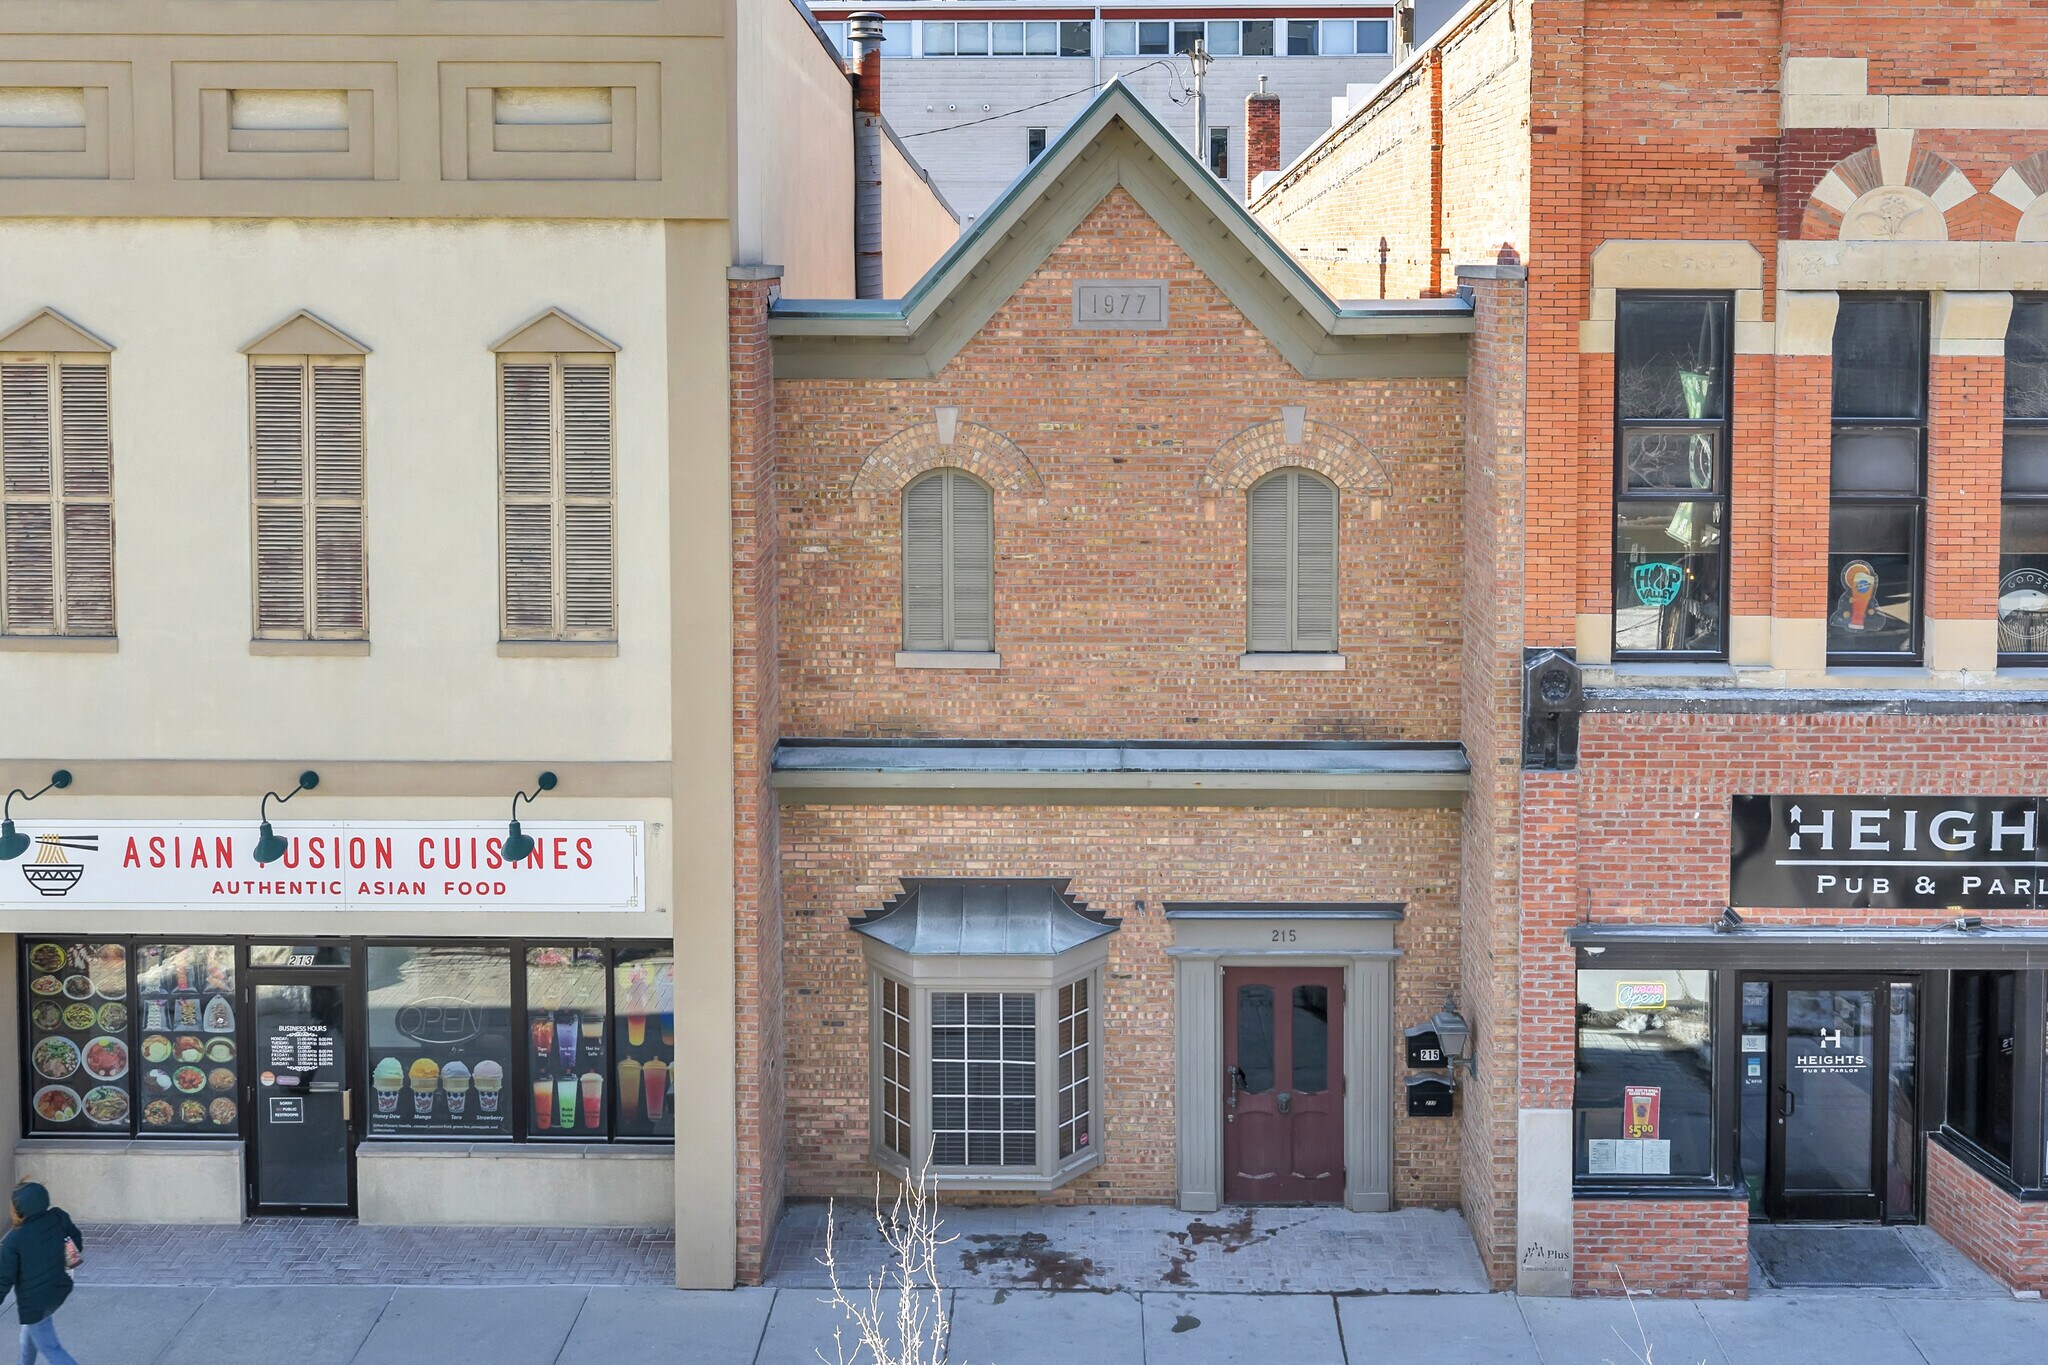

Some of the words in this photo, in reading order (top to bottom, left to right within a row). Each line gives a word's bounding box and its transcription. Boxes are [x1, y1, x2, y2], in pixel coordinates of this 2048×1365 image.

[1093, 294, 1147, 314] 1977
[2008, 574, 2048, 590] GOOSE
[1640, 589, 1674, 600] VALLEY
[1788, 804, 2037, 852] HEIGH
[122, 836, 233, 869] ASIAN
[259, 836, 392, 869] USION
[418, 836, 593, 870] CUISNES
[212, 881, 343, 895] AUTHENTIC
[358, 881, 426, 896] ASIAN
[444, 881, 507, 896] FOOD
[1816, 874, 1890, 894] PUB
[1914, 875, 1936, 895] &
[1271, 929, 1297, 942] 215
[288, 955, 313, 966] 213
[1619, 985, 1664, 1009] Open
[400, 1006, 482, 1035] OPEN
[1421, 1050, 1439, 1060] 215
[1797, 1055, 1865, 1065] HEIGHTS
[1547, 1250, 1570, 1260] Plus
